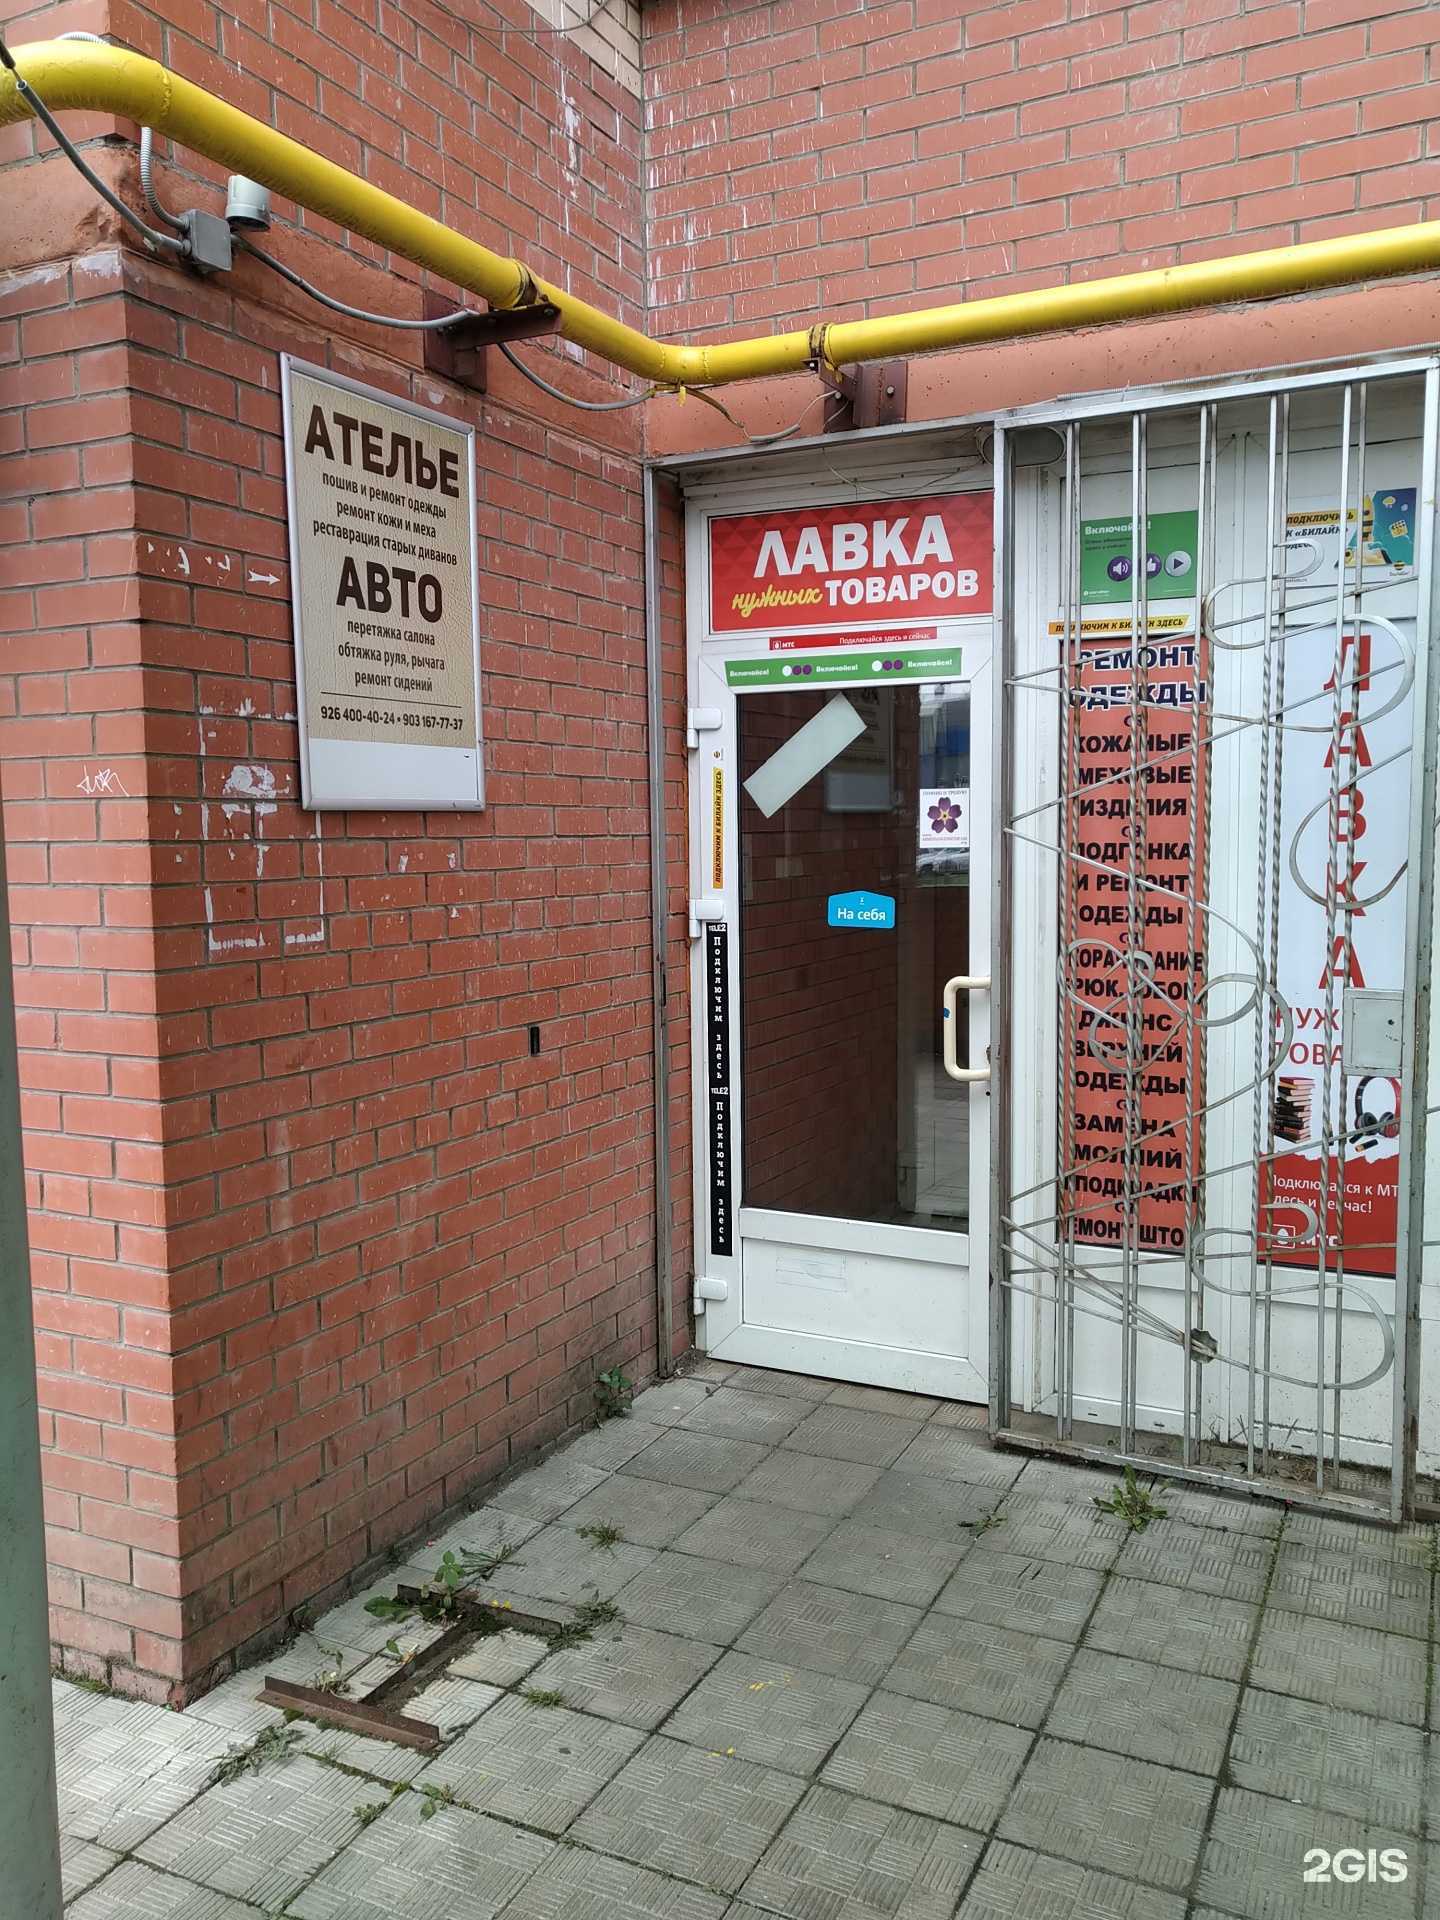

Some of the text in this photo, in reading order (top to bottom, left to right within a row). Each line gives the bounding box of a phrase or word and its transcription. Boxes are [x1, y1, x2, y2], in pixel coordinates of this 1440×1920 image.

[305, 404, 460, 498] АТЕЛЬЕ
[322, 472, 447, 519] пошив и ремонт одежды
[336, 501, 437, 538] ремонт кожи и меха
[1286, 512, 1354, 525] ПОДКЛЮЧИЬ
[313, 520, 458, 566] реставрация старых диванов
[753, 515, 954, 578] ЛАВКА
[336, 556, 443, 623] АВТО
[732, 569, 979, 618] нужных ТОВАРОВ
[347, 620, 435, 646] перетяжка салона
[839, 634, 882, 645] Подключайся
[883, 633, 902, 643] здесь
[908, 630, 931, 641] сейчас
[1111, 622, 1117, 630] К
[1156, 619, 1184, 628] ЗДЕСЬ
[338, 642, 445, 670] обтяжка руля, рычага
[354, 671, 433, 692] ремонт сидений
[320, 706, 463, 731] 926 400-40-24 903 167-77-37
[837, 908, 886, 921] На себя
[713, 936, 723, 1079] Подключим здесь
[710, 1087, 729, 1095] TELE2
[1075, 1113, 1176, 1137] ЗАМНА
[715, 1101, 725, 1243] Подключим здесь
[1365, 1184, 1373, 1196] к
[1377, 1183, 1400, 1197] МТ
